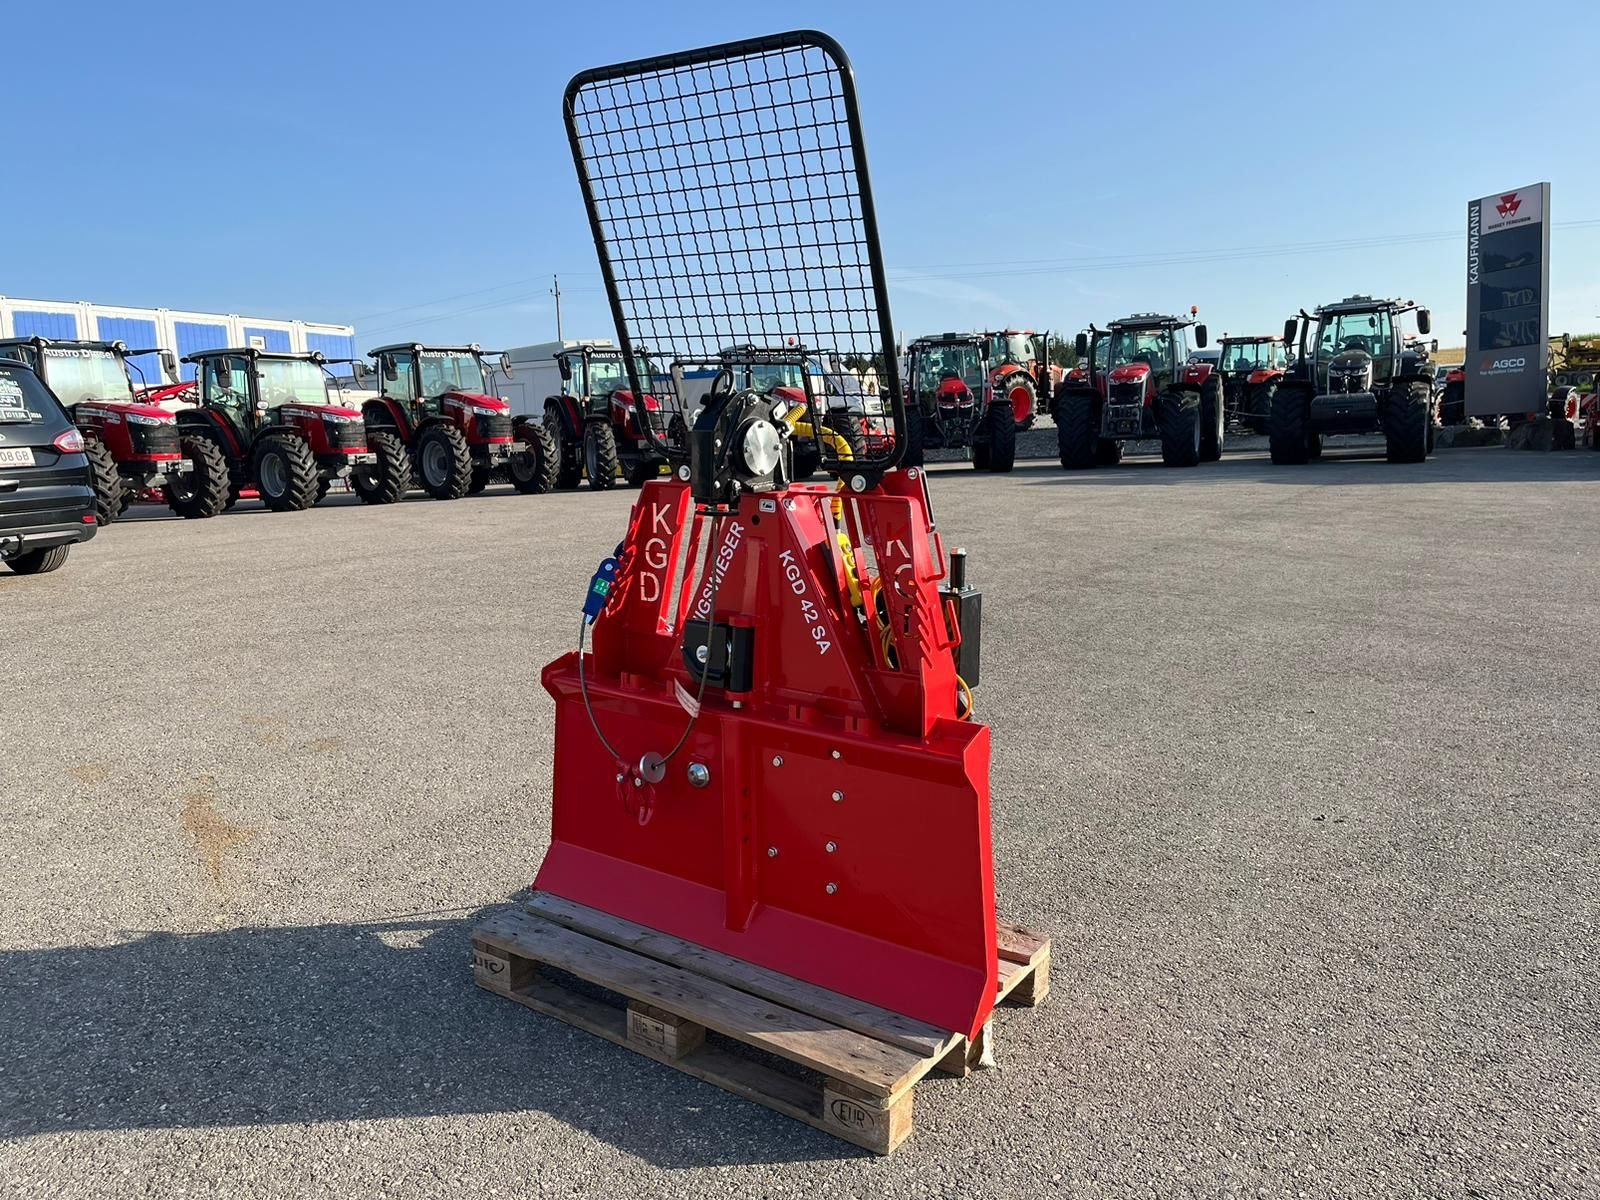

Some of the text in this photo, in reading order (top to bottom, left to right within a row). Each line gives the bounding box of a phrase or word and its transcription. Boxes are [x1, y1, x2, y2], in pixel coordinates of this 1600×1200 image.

[1469, 205, 1479, 285] KAUFMANN
[43, 347, 79, 358] Austro
[419, 350, 473, 359] Austro Diesel
[590, 351, 617, 359] Austro
[1492, 357, 1526, 369] AGCO
[640, 502, 673, 602] KGD
[778, 549, 832, 655] KGD 42 SA
[839, 1102, 865, 1128] EUR
